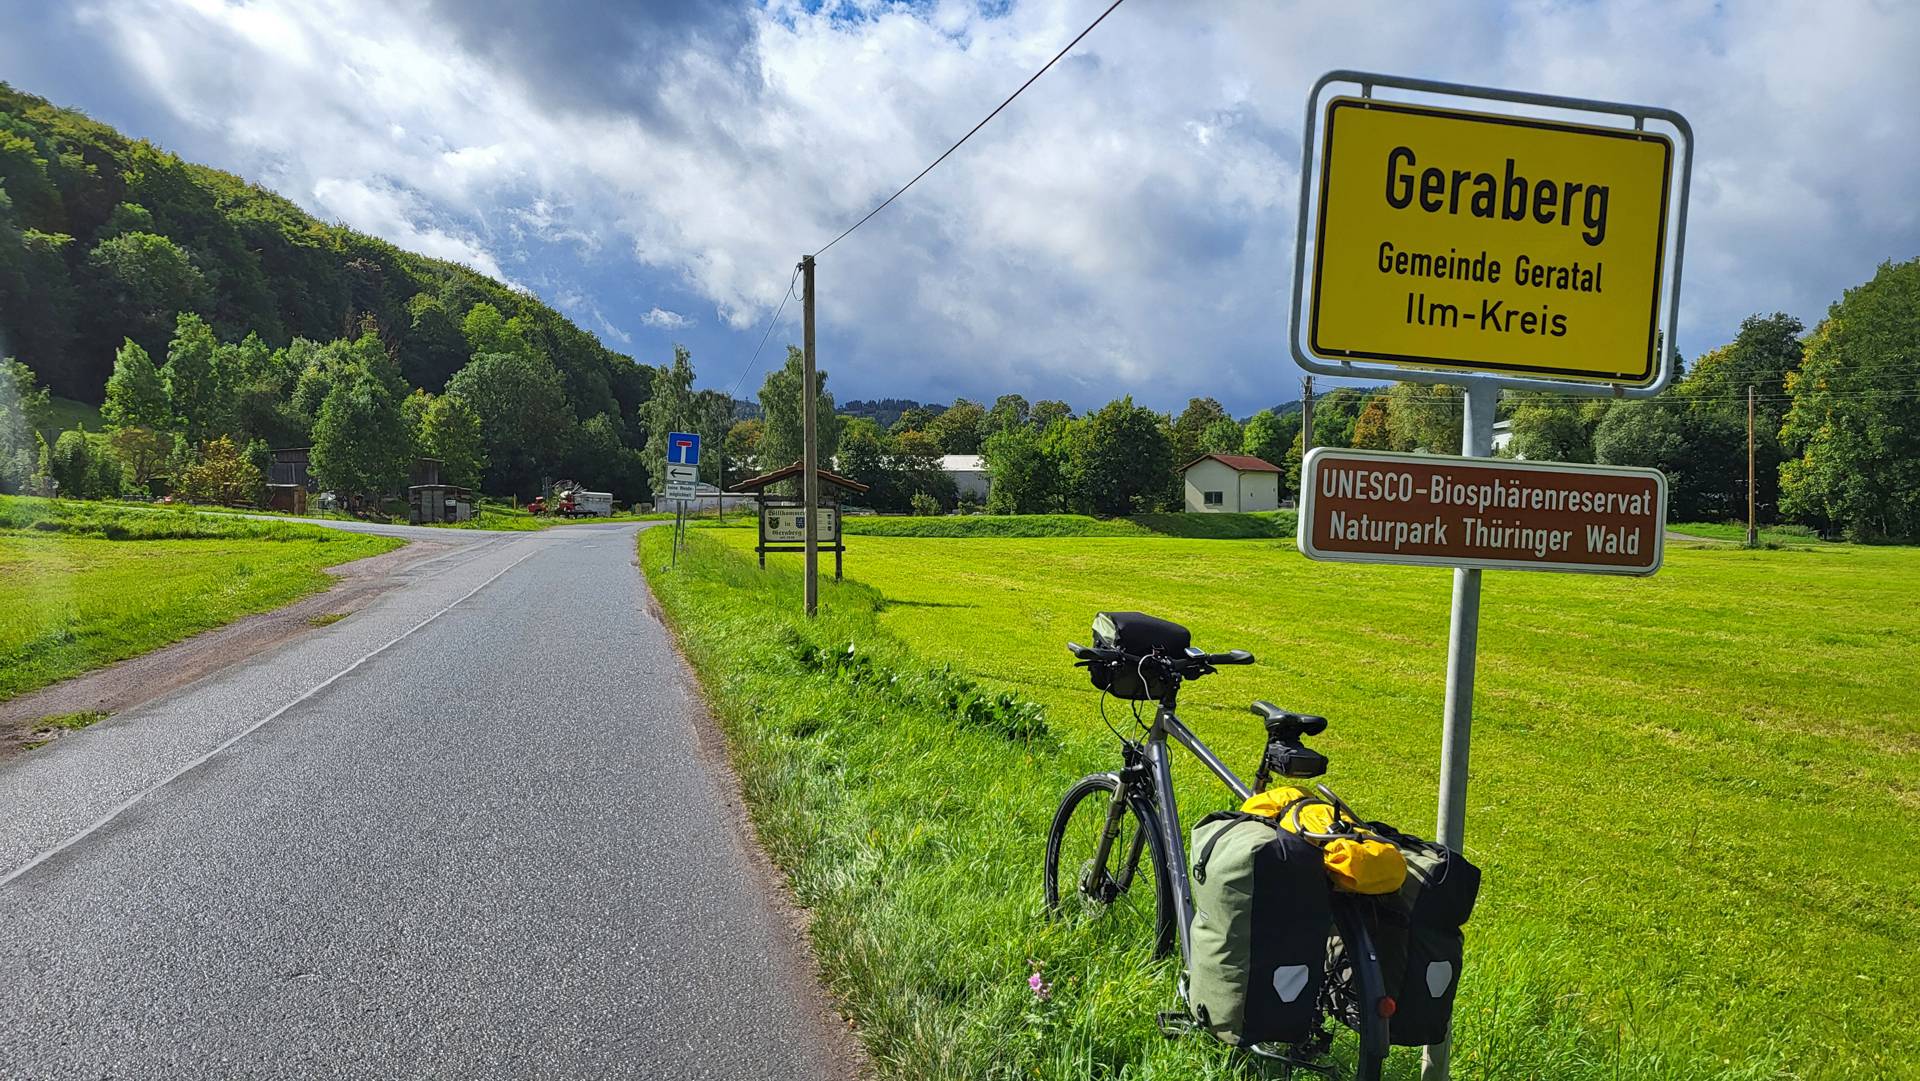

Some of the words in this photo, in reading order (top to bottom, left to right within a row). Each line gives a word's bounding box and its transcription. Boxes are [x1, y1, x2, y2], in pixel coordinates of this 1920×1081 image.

[1385, 146, 1610, 247] Geraberg
[1378, 241, 1501, 284] Gemeinde
[1514, 254, 1603, 294] Geratal
[1406, 292, 1568, 338] Ilm-Kreis
[1322, 467, 1652, 516] UNESCO-Biosphärenreservat
[1329, 510, 1448, 550] Naturpark
[1463, 517, 1573, 558] Thüringer
[1586, 524, 1640, 556] Wald
